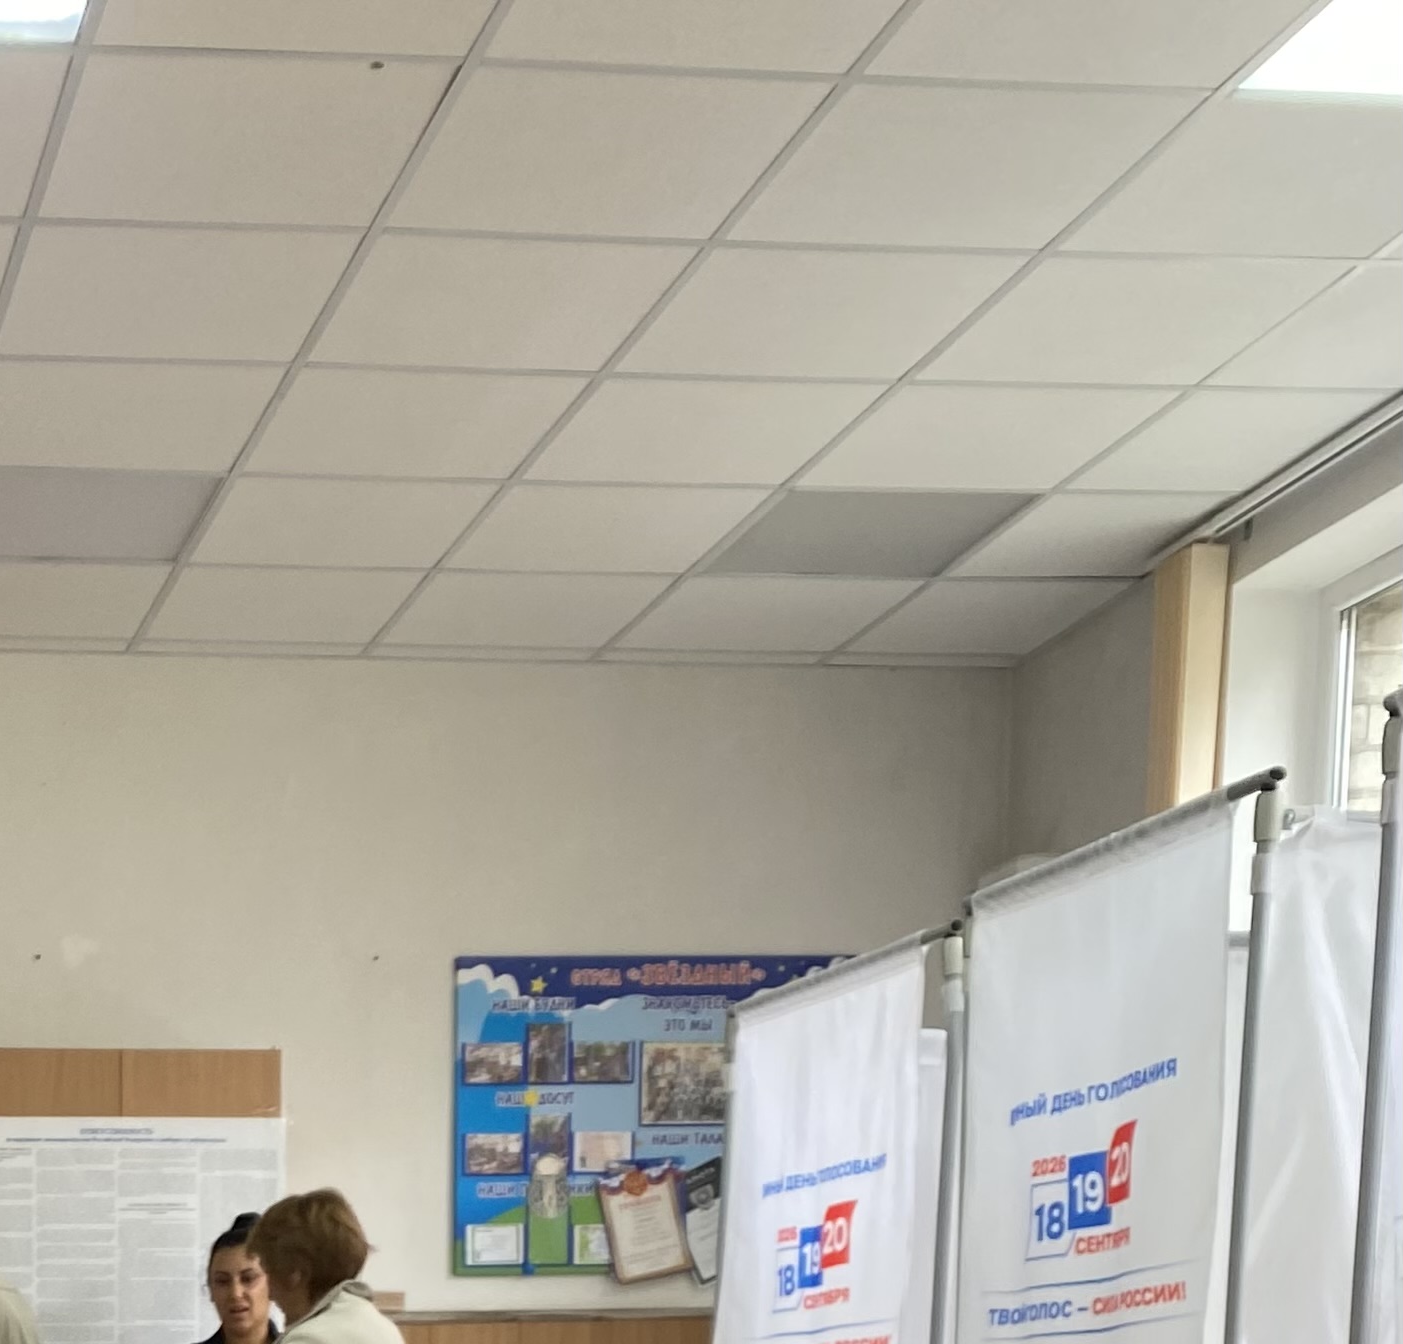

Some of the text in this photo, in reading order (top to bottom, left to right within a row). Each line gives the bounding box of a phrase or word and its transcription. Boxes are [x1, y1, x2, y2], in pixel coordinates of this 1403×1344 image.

[664, 1019, 713, 1031] ЭТО МЫ
[1050, 1089, 1085, 1115] ДЕНЬ
[1031, 1155, 1066, 1177] 2026
[1072, 1170, 1104, 1214] 19
[822, 1217, 848, 1255] 20
[1035, 1201, 1064, 1242] 18
[802, 1241, 821, 1276] 19
[777, 1264, 795, 1297] 18
